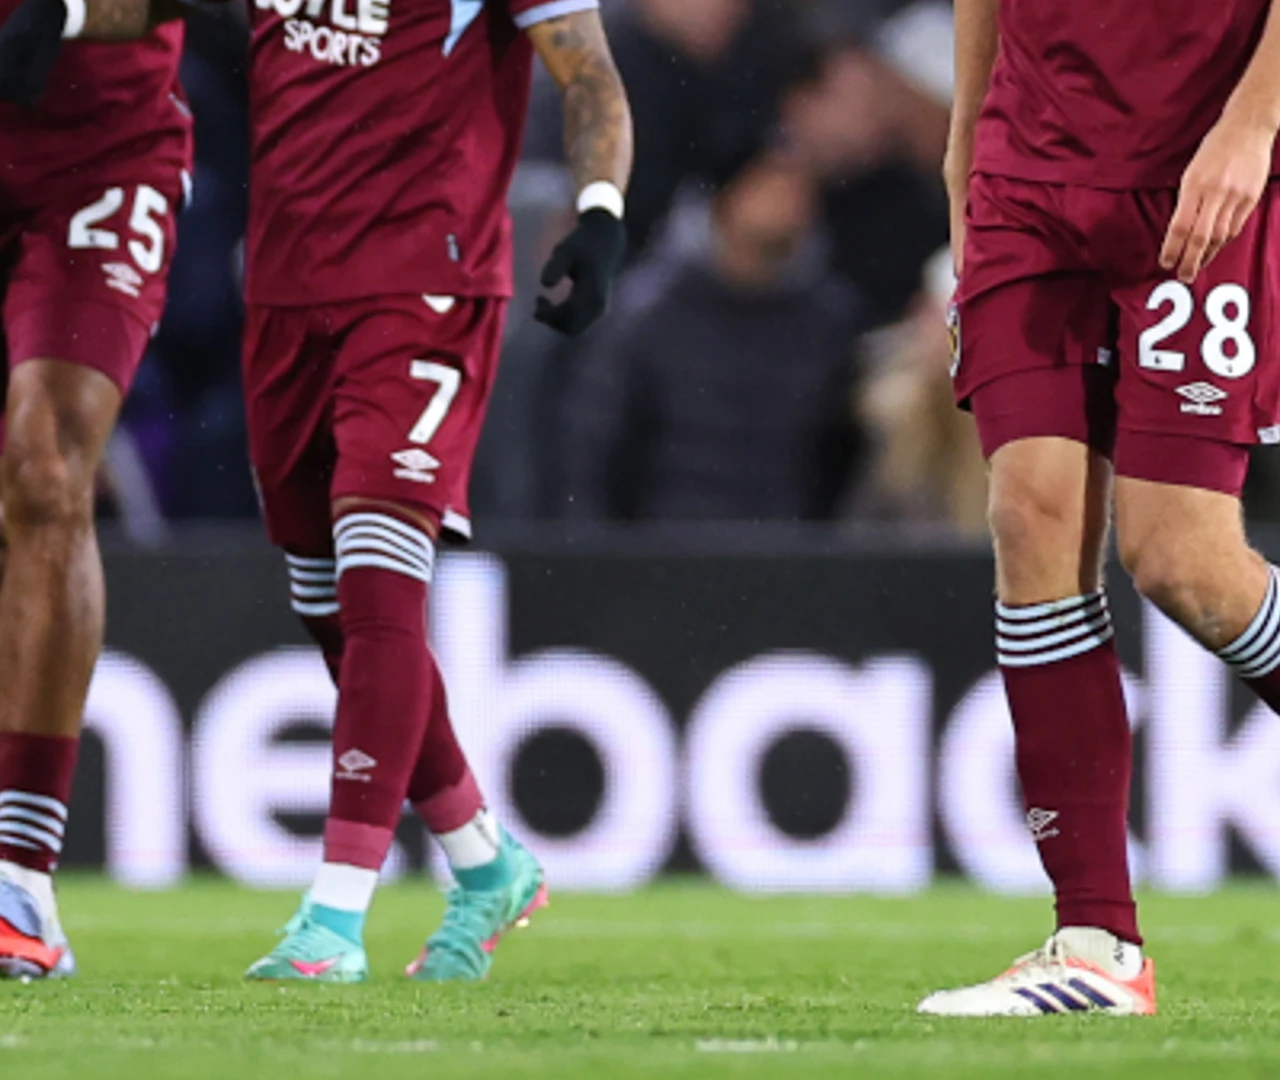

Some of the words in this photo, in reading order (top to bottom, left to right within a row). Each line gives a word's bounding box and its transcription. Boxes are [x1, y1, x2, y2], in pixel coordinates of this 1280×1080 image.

[283, 18, 382, 66] SPORTS
[68, 185, 169, 273] 25
[1138, 280, 1257, 378] 28
[409, 360, 462, 444] 7
